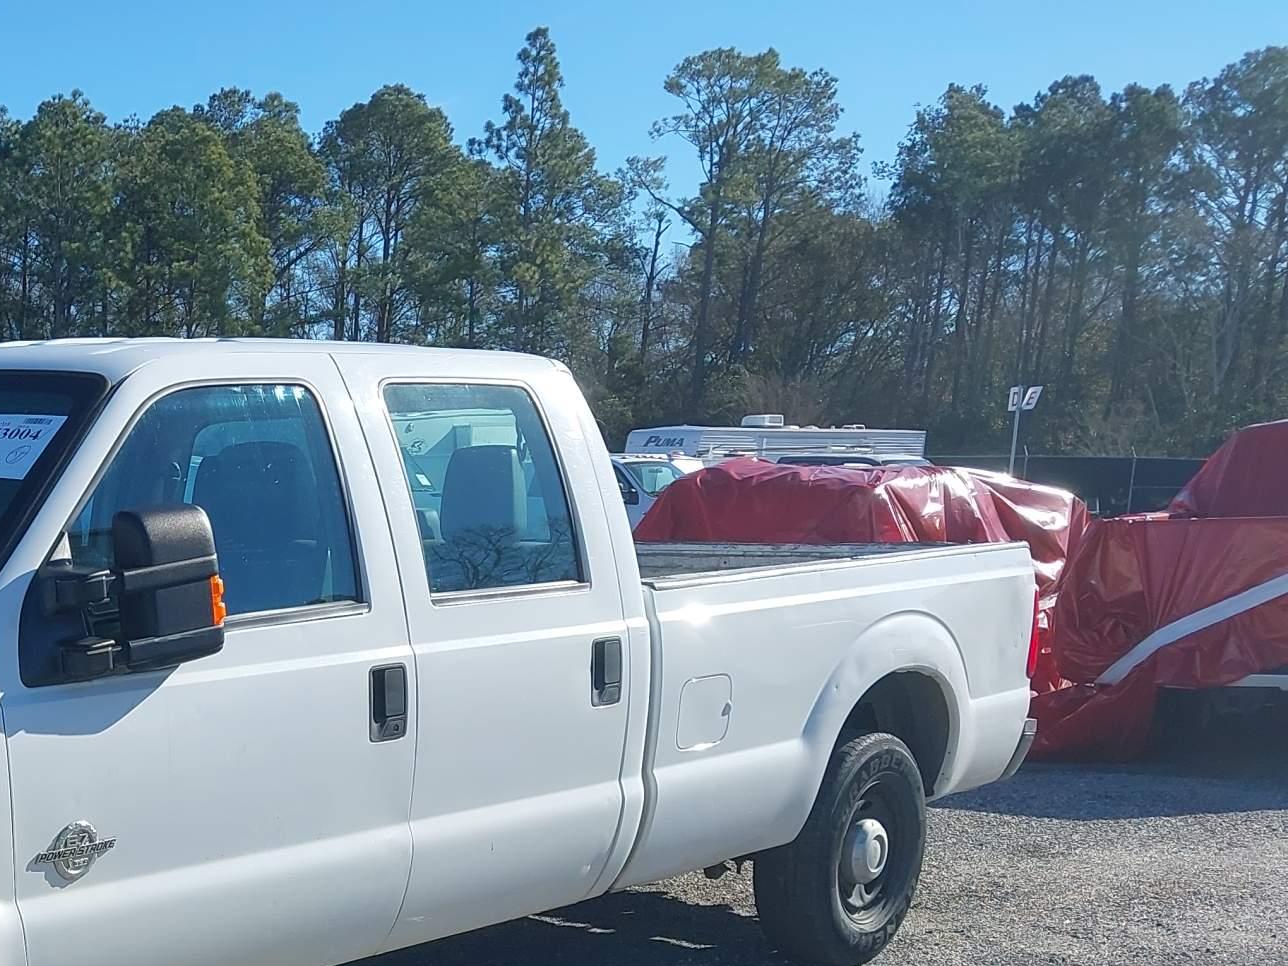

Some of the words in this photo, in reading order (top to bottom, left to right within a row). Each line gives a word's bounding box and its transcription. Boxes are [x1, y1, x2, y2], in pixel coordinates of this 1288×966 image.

[1026, 391, 1037, 405] E
[39, 847, 76, 863] POWER
[76, 838, 117, 856] STROKE
